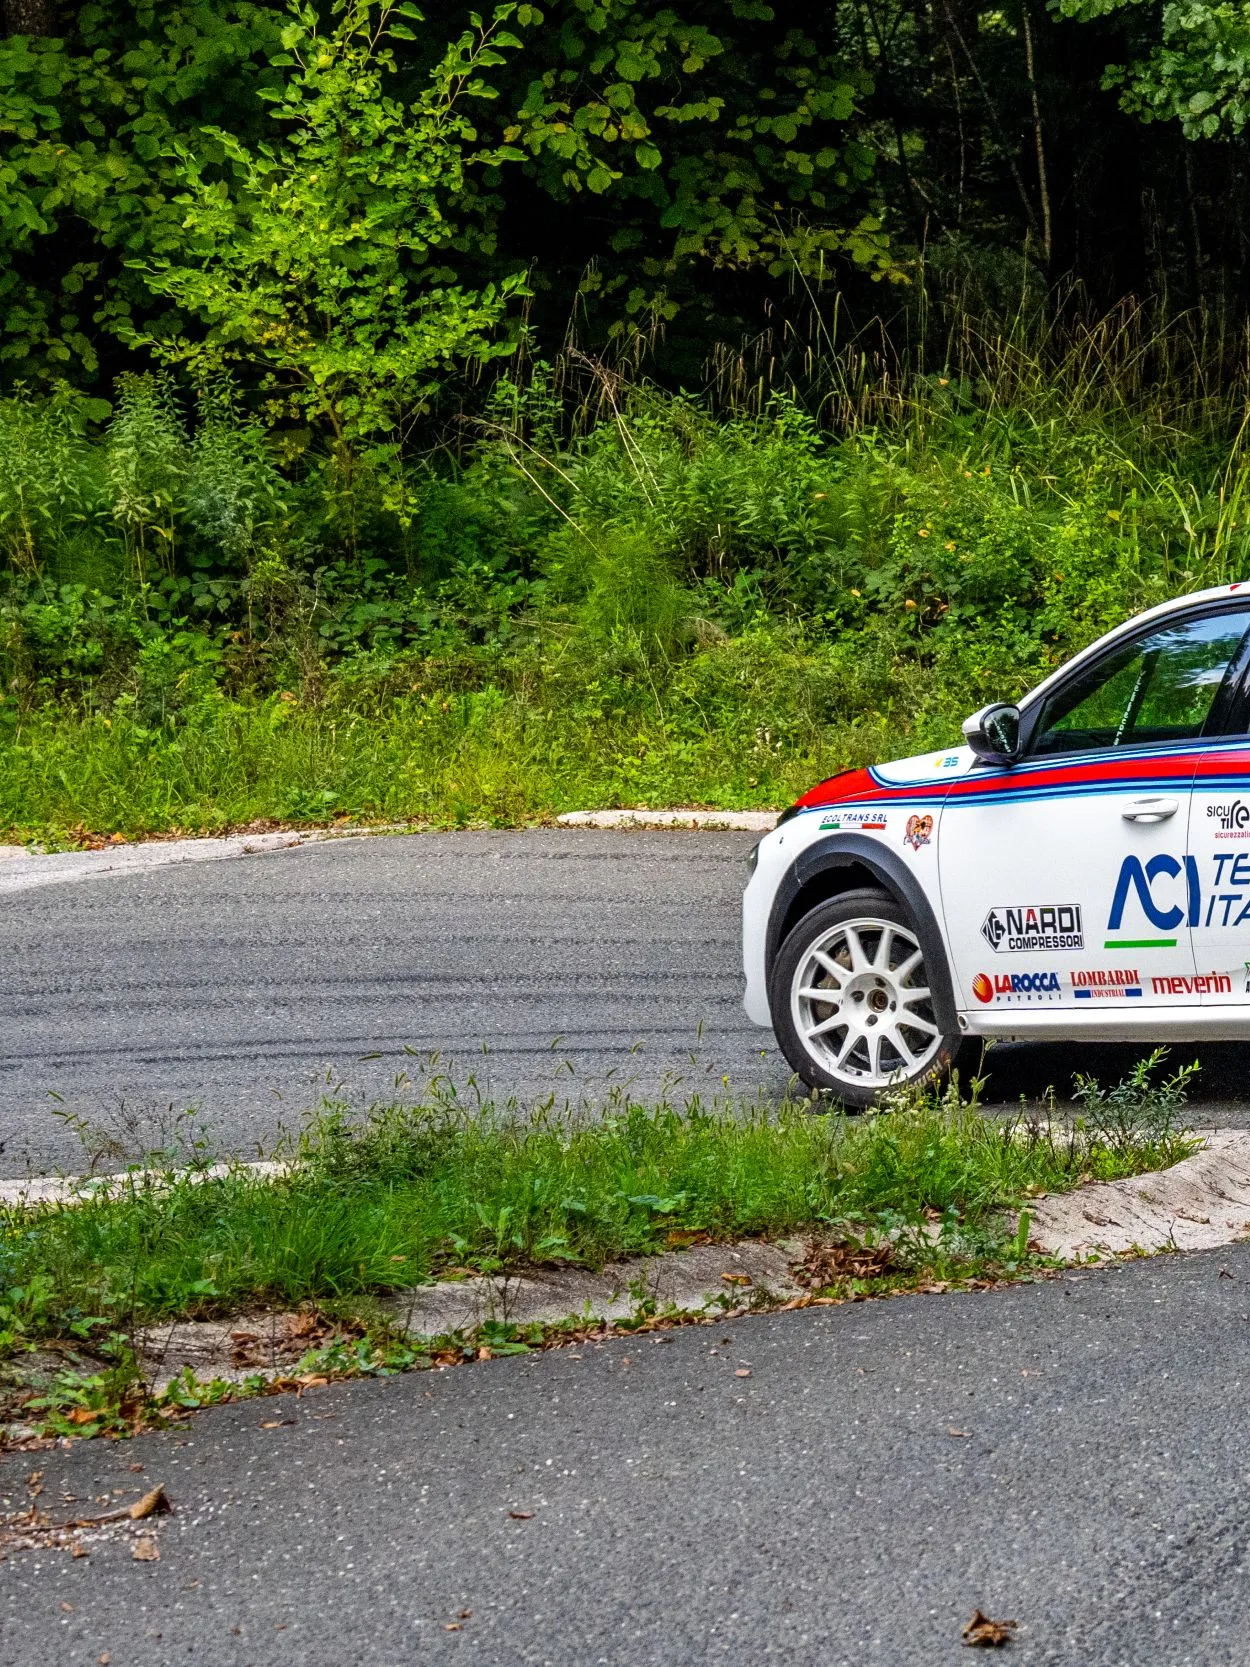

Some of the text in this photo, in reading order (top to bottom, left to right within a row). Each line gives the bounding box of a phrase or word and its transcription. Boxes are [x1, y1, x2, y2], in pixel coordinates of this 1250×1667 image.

[871, 813, 888, 823] SRL
[1107, 853, 1201, 931] ACI
[1006, 906, 1082, 936] NARDI
[1008, 935, 1083, 950] COMPRESSORI
[994, 972, 1061, 994] LAROCCA
[1069, 969, 1140, 987] LOMBARDI
[1151, 971, 1232, 995] meverin
[996, 994, 1062, 1002] PETROLI
[1091, 988, 1126, 998] INDUSTRIAL
